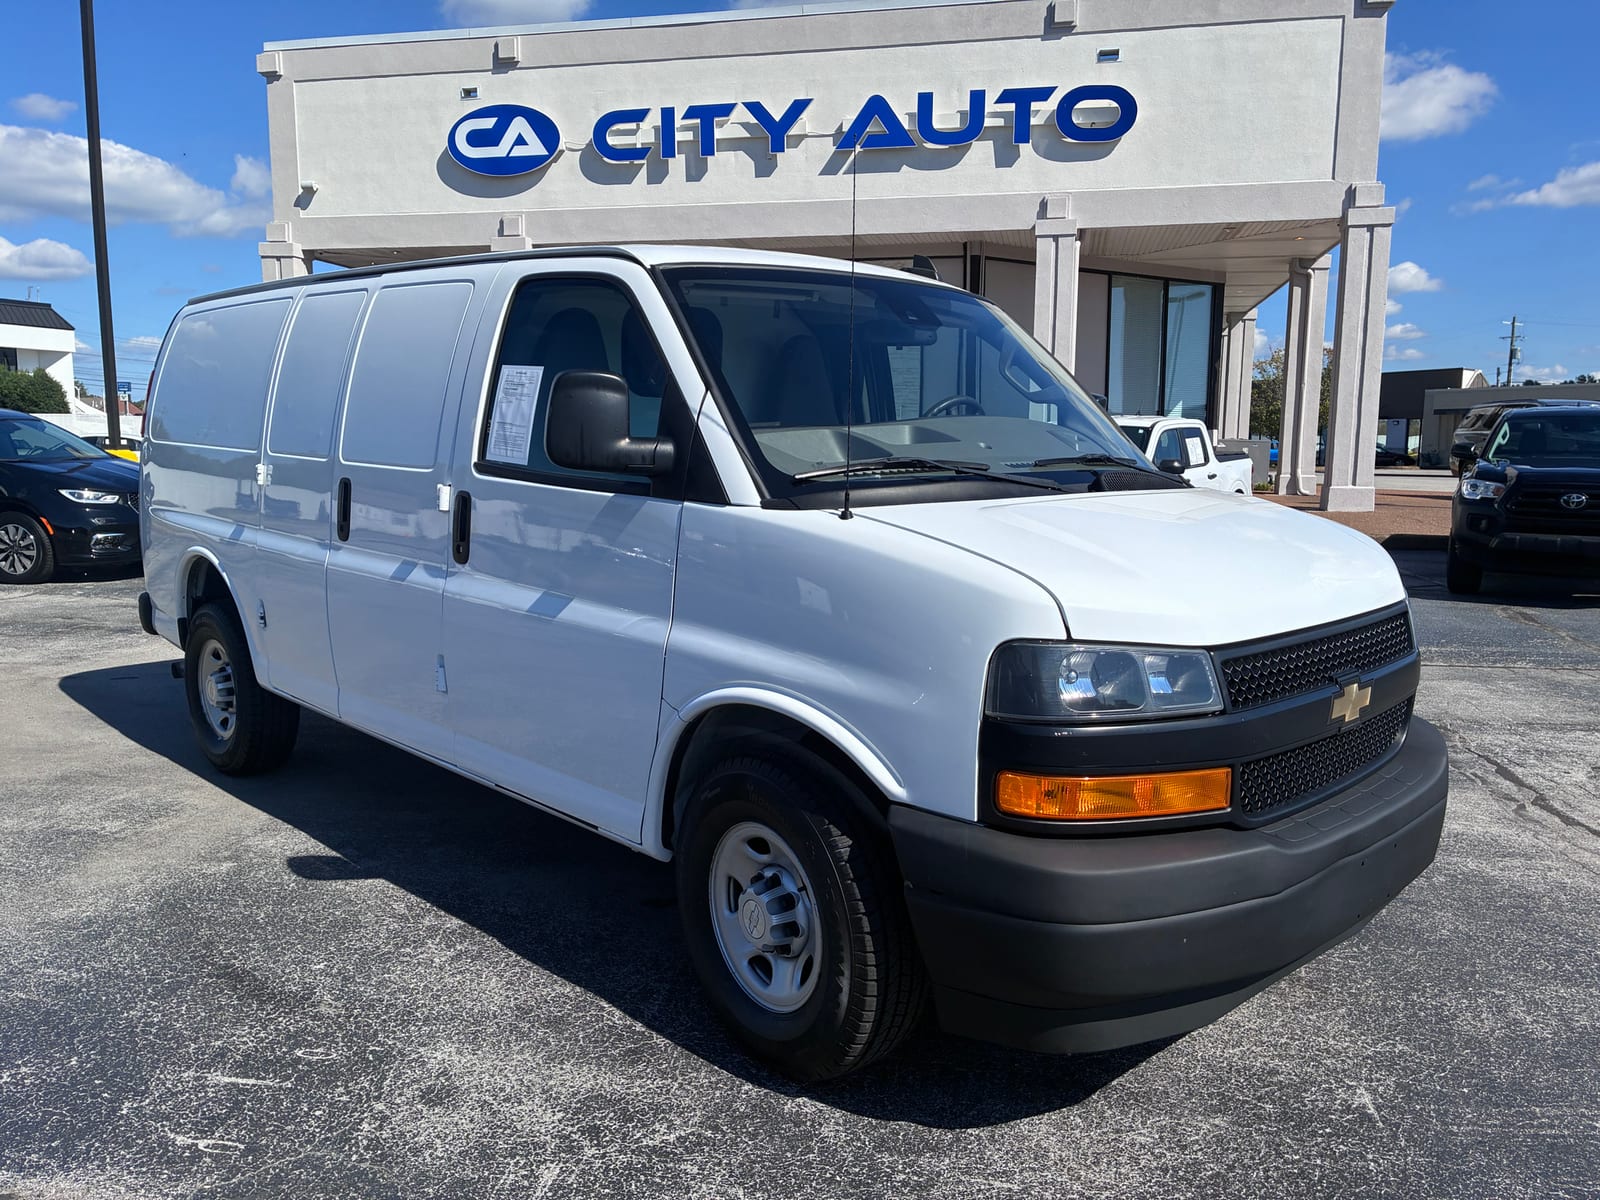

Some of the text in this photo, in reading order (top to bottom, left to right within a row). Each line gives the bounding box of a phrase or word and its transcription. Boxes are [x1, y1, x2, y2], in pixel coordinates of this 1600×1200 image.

[454, 84, 1138, 164] CA CITY AUTO
